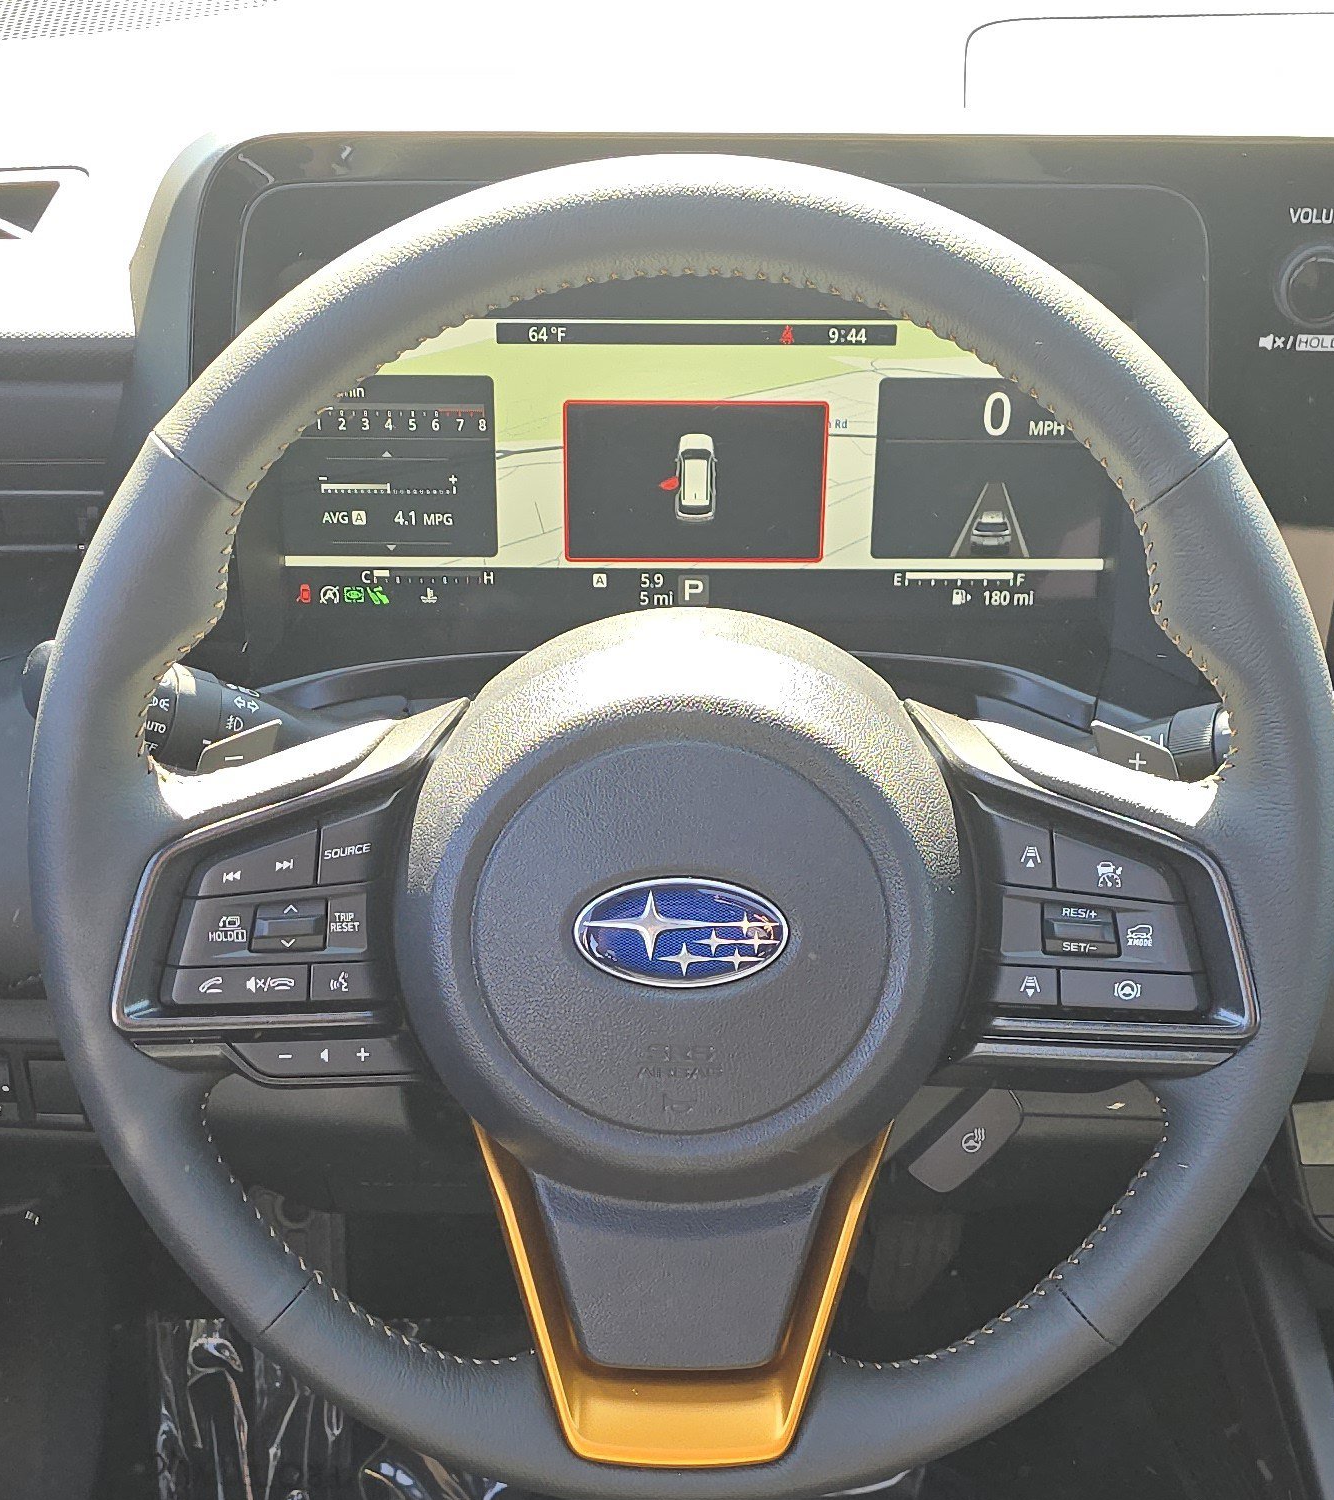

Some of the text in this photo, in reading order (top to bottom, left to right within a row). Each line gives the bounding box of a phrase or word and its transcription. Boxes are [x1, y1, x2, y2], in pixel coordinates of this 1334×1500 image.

[828, 328, 868, 344] 9:44
[983, 391, 1012, 437] 0
[338, 418, 347, 431] 2
[361, 418, 370, 431] 3
[384, 418, 393, 431] 4
[408, 418, 417, 431] 5
[431, 418, 440, 431] 6
[456, 418, 465, 432] 7
[478, 418, 487, 432] 8
[1028, 420, 1066, 437] MPH
[322, 511, 349, 524] AVG
[394, 511, 417, 526] 4.1
[423, 513, 454, 526] MPG
[361, 571, 494, 585] C H
[640, 573, 665, 589] 5.9
[893, 573, 1026, 587] E F
[683, 579, 705, 601] P
[639, 591, 674, 606] 5 mi
[983, 591, 1034, 606] 180 mi
[145, 721, 167, 734] UTO
[323, 843, 372, 860] SOURCE
[334, 912, 355, 923] TRIP
[1061, 907, 1098, 919] RES/+
[330, 920, 361, 932] RESET
[208, 931, 235, 942] HOLD
